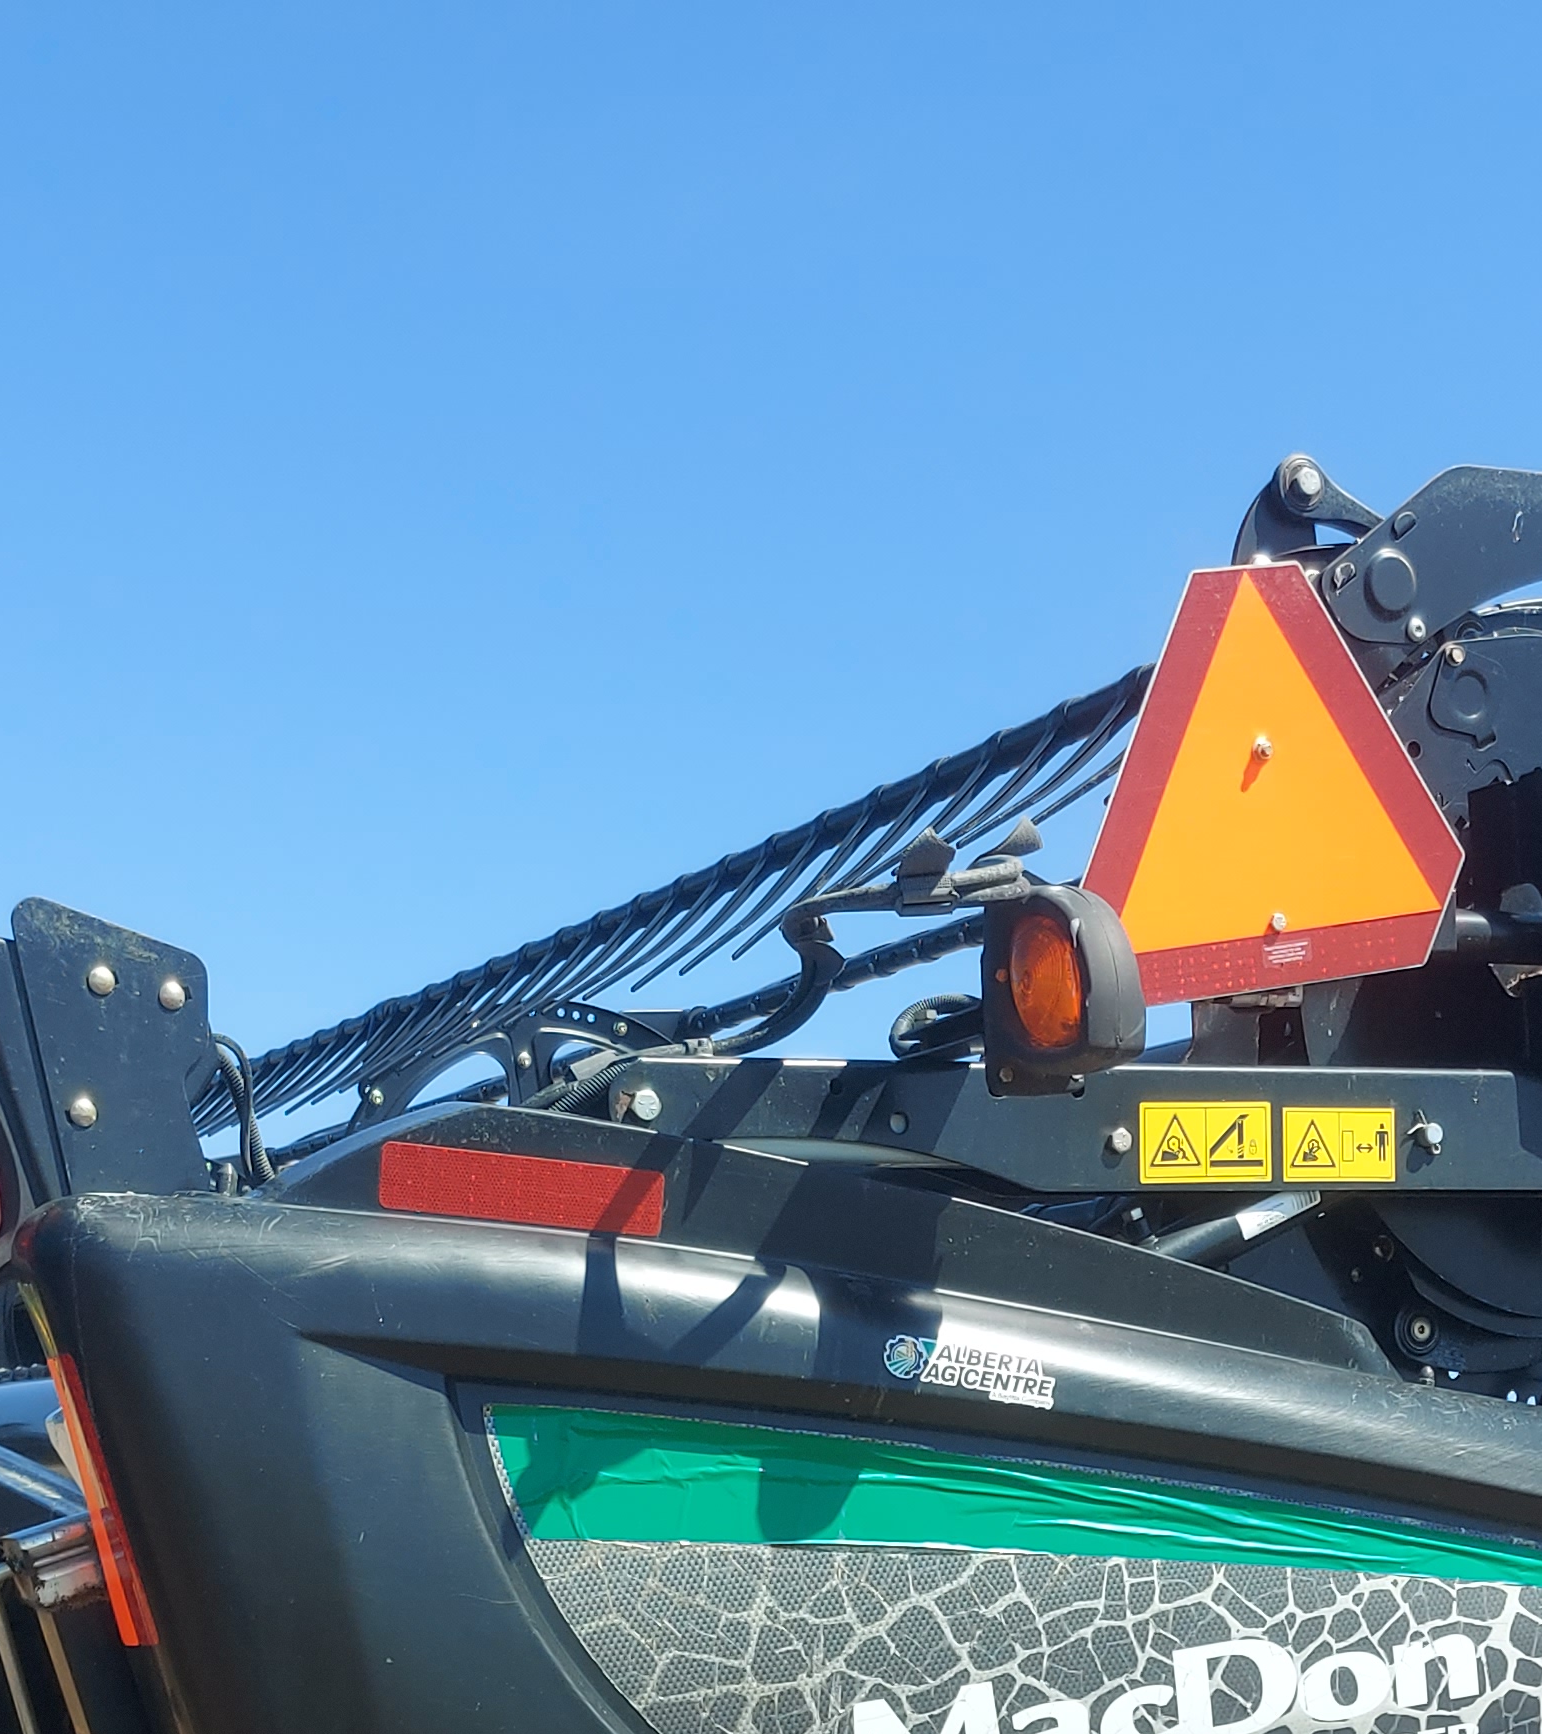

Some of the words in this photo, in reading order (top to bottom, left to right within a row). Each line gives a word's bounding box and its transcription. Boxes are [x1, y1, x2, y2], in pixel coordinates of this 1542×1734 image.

[936, 1344, 1040, 1376] ALBERTA
[924, 1363, 957, 1383] AG
[963, 1367, 1052, 1397] CENTRE
